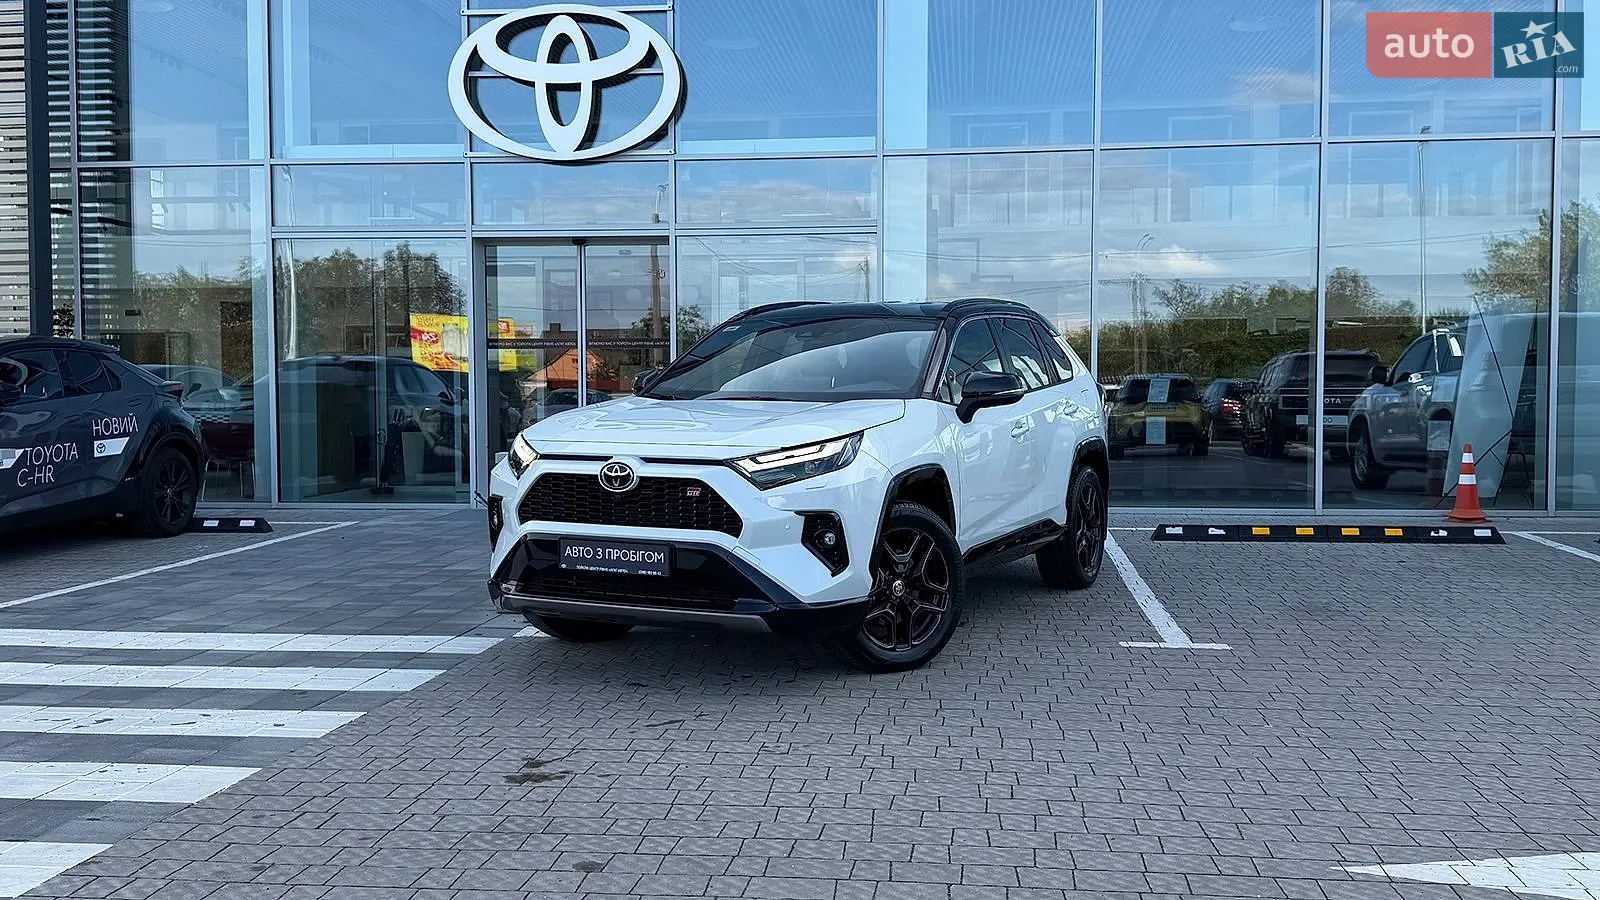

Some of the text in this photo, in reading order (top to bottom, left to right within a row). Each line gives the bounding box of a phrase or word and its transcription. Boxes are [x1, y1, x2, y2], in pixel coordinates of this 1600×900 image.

[92, 412, 139, 437] НОВИЙ
[25, 442, 79, 466] TOYOTA
[17, 465, 55, 487] C-HR
[686, 488, 701, 497] GR
[564, 545, 594, 559] АВТО
[605, 548, 665, 564] ПРОБІГОМ
